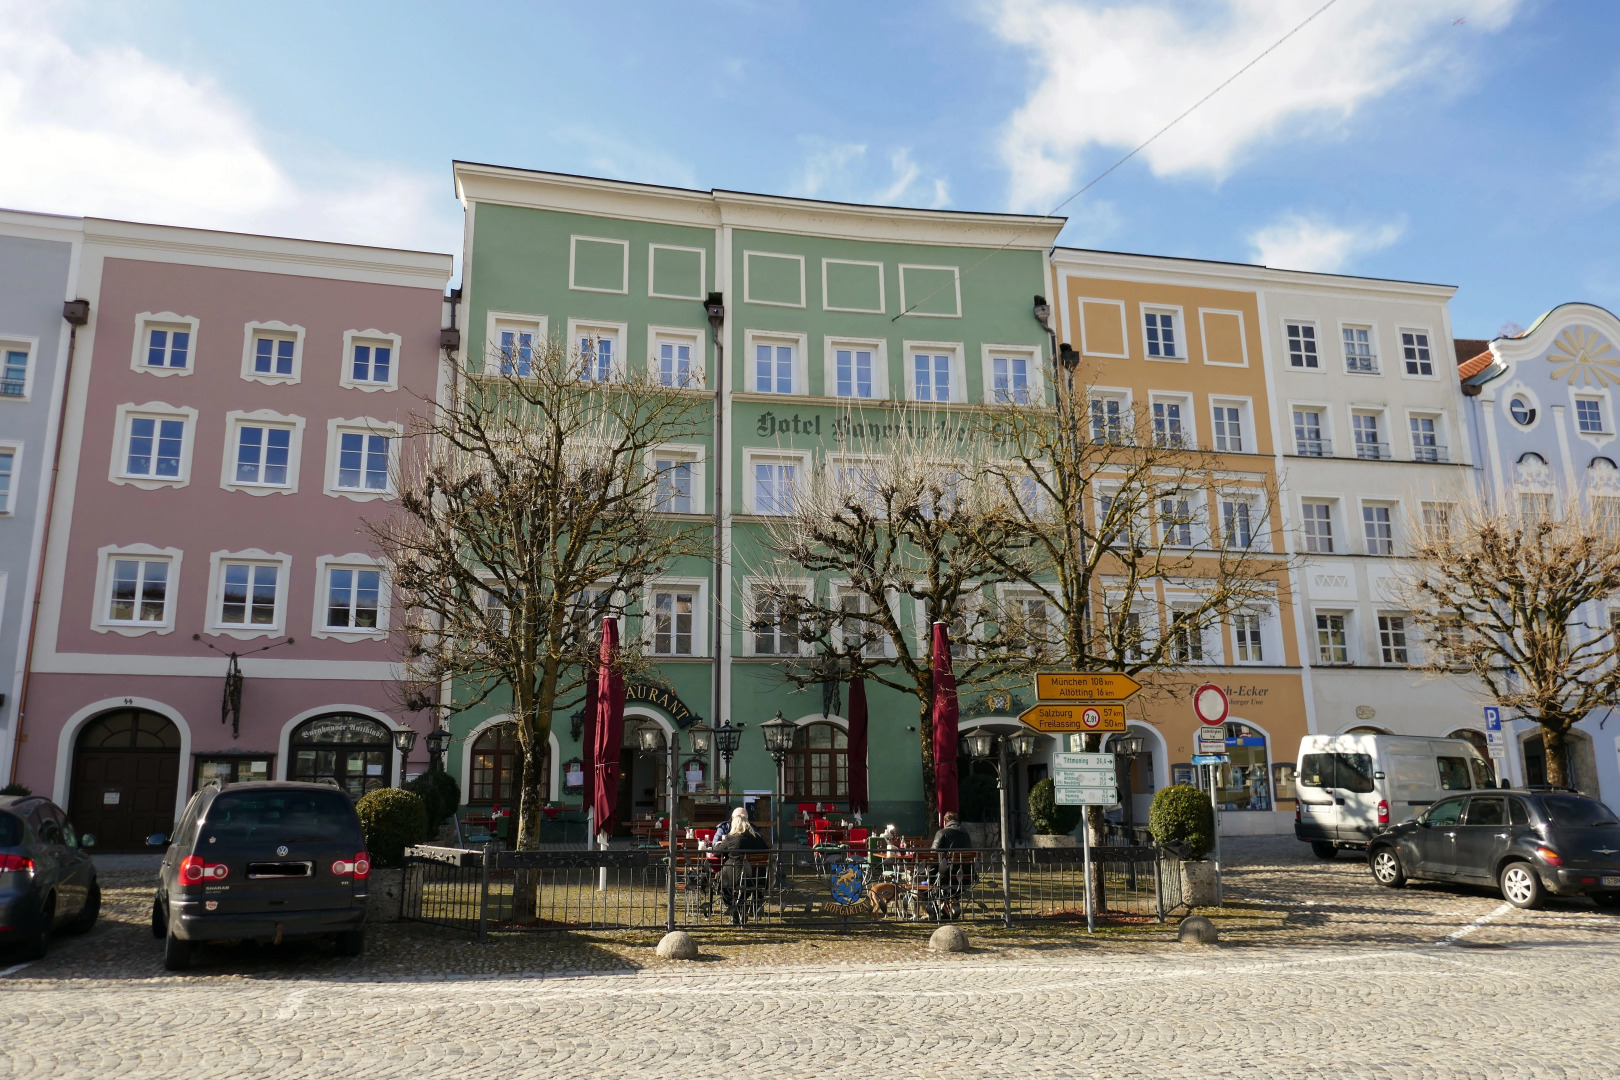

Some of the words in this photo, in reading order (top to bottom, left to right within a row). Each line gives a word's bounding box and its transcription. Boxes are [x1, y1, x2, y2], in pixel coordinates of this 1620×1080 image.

[757, 410, 821, 437] Hotel
[1051, 677, 1088, 686] München
[1091, 678, 1103, 686] 108
[1060, 688, 1093, 698] Altötting
[1096, 688, 1104, 696] 16
[625, 685, 690, 720] AURANT
[1040, 708, 1072, 718] Salzburg
[1104, 708, 1112, 716] 57
[1040, 720, 1080, 729] Freilassing
[1104, 720, 1114, 728] 50
[302, 724, 346, 738] Burghauser
[1064, 756, 1088, 765] Tittmoning
[824, 902, 868, 916] HOFGARTEN
